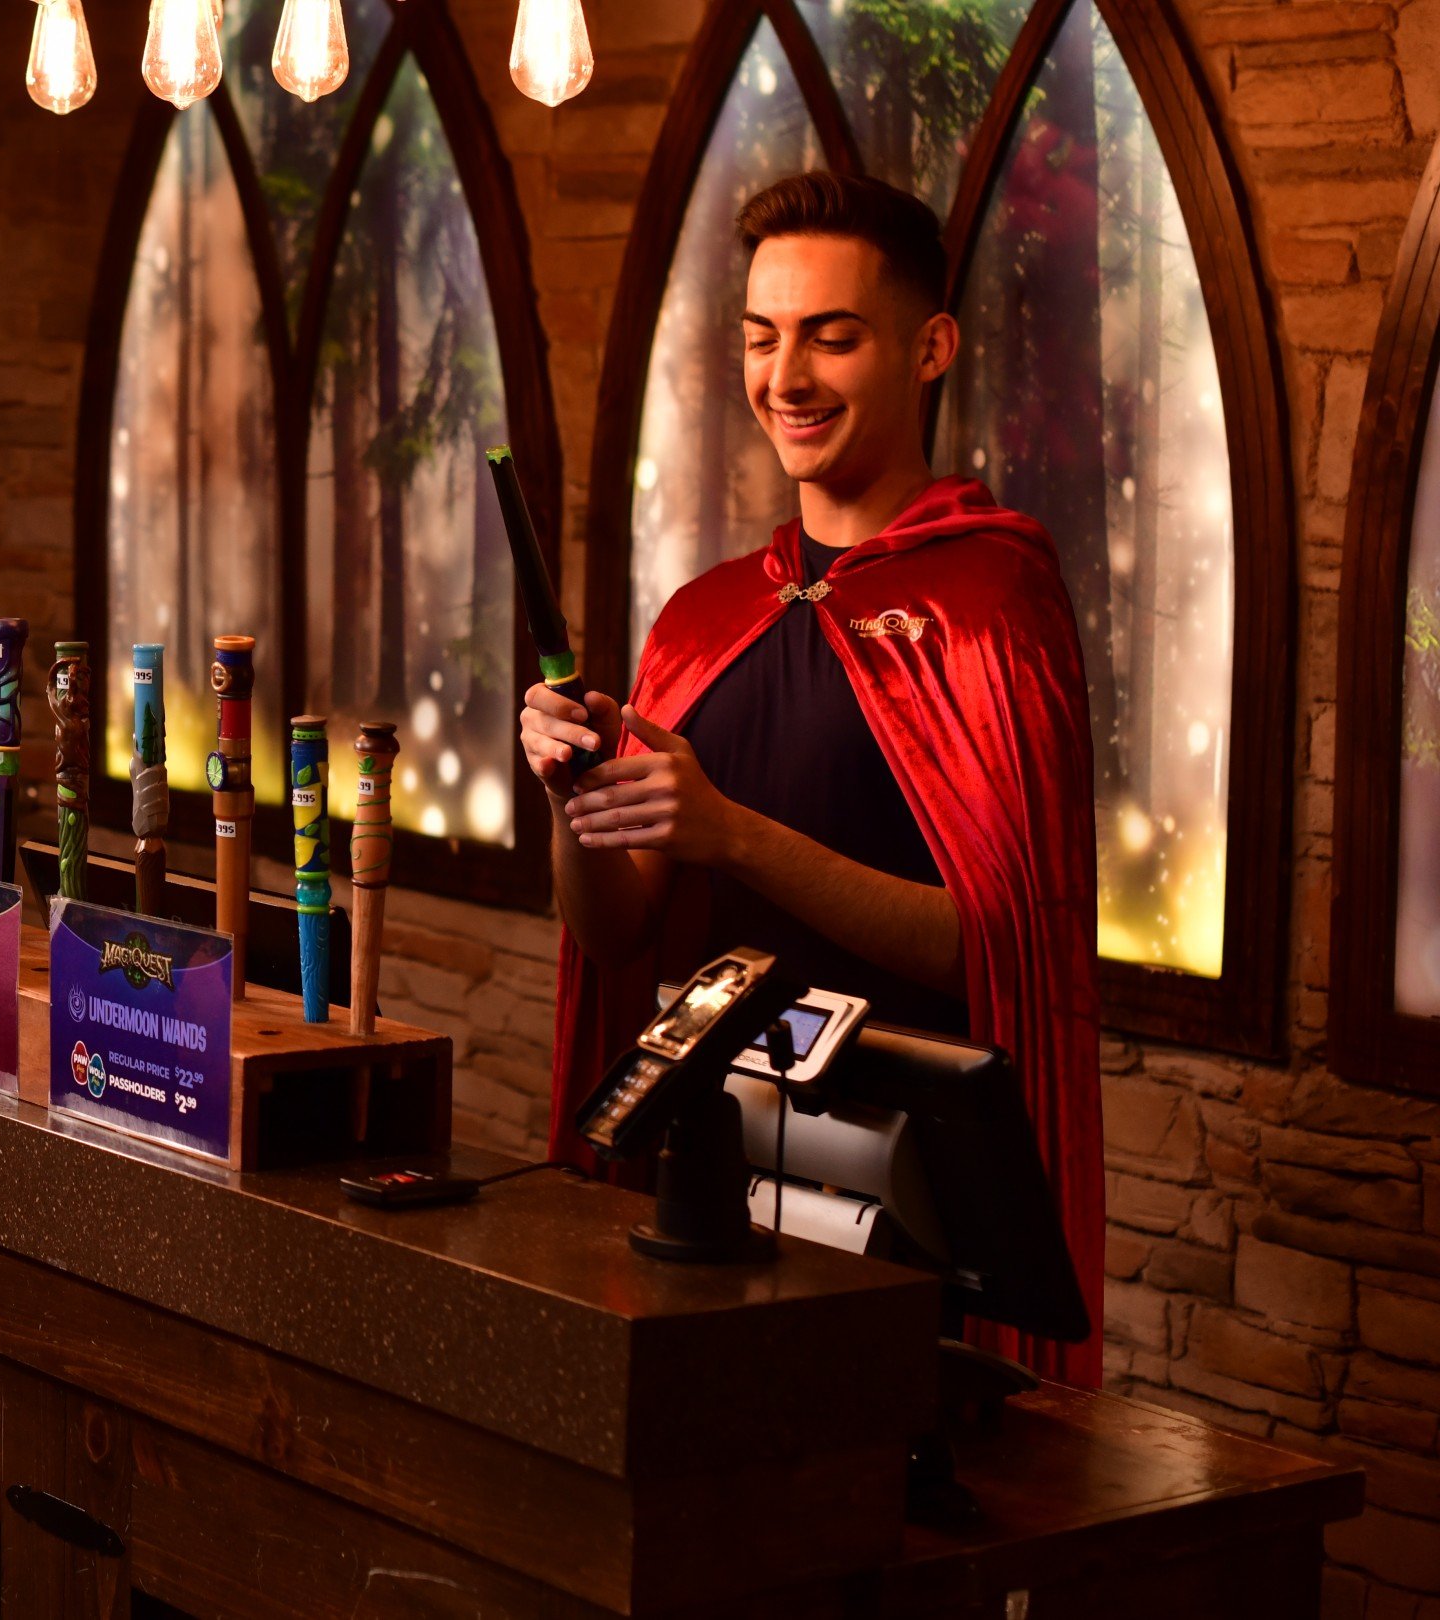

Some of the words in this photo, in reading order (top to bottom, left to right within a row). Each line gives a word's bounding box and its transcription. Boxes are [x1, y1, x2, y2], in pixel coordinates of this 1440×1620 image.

[89, 995, 159, 1040] UNDERMOON
[161, 1015, 207, 1053] WANDS
[73, 1053, 88, 1067] PAW
[89, 1065, 105, 1080] WOLF
[109, 1050, 146, 1073] REGULAR
[146, 1062, 170, 1080] PRICE
[109, 1074, 166, 1103] PASSHOLDERS
